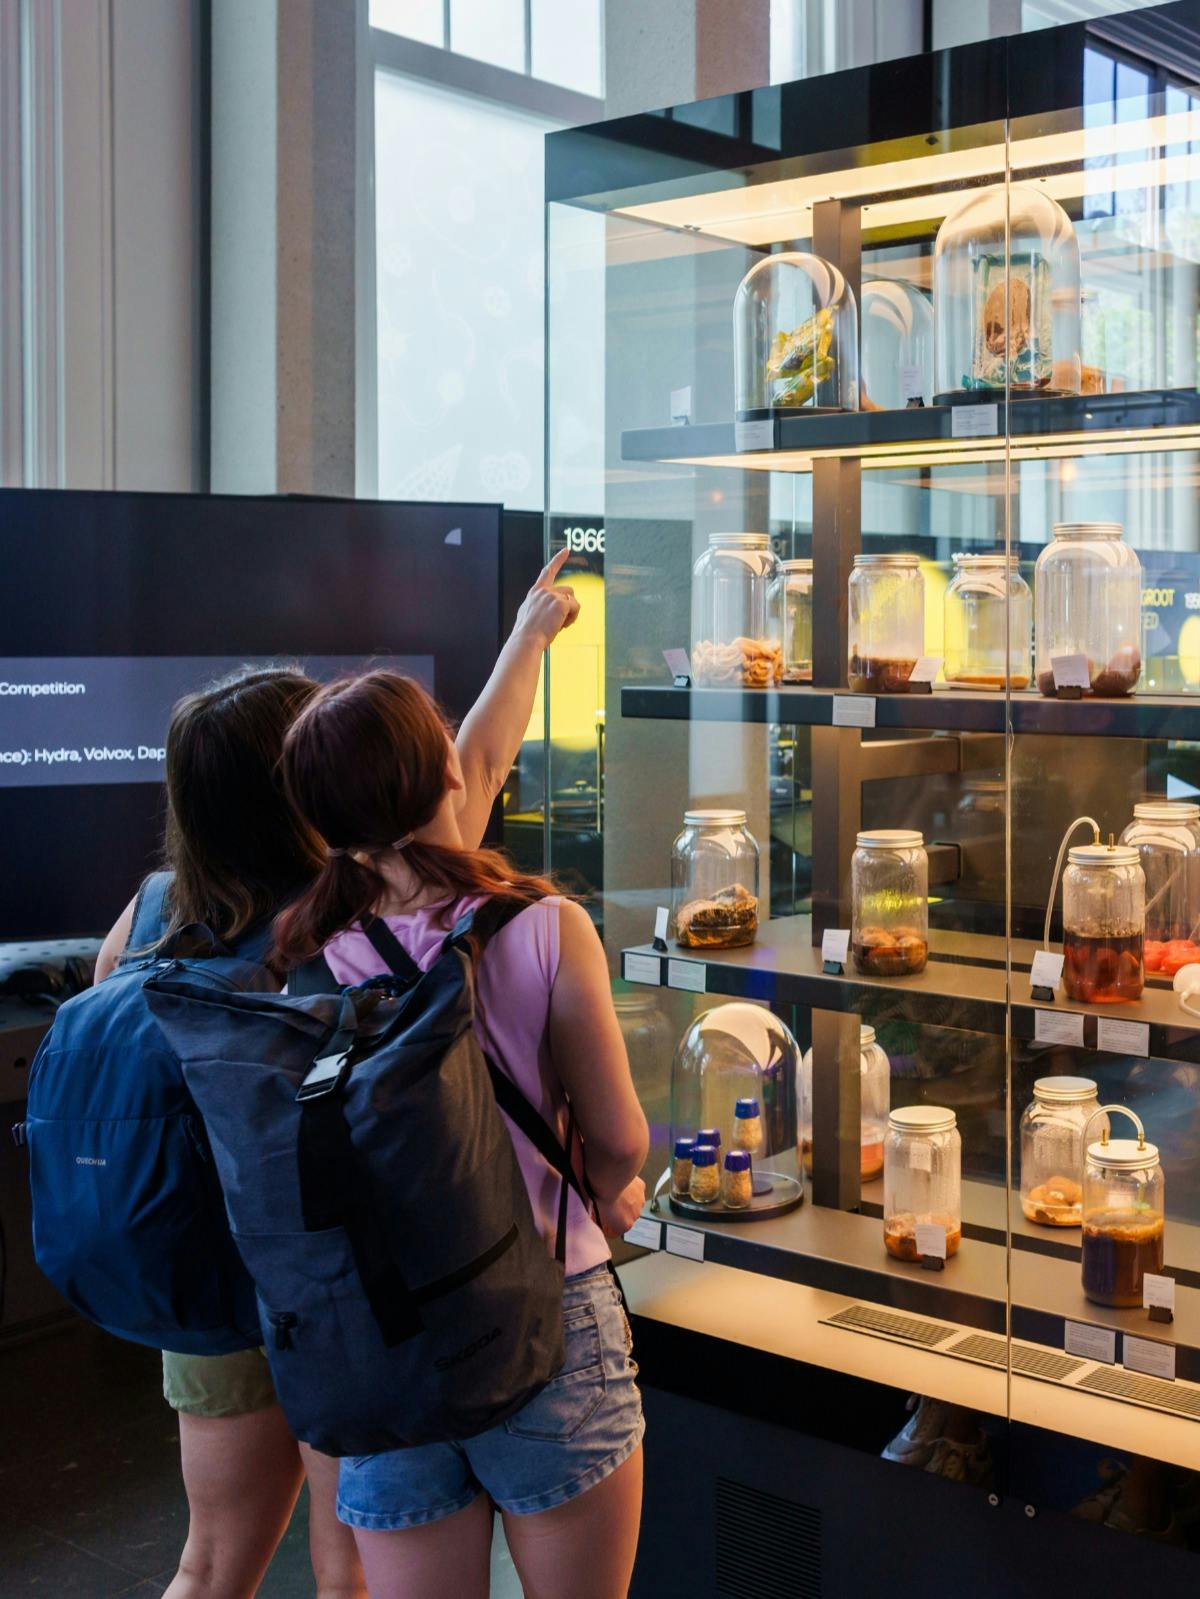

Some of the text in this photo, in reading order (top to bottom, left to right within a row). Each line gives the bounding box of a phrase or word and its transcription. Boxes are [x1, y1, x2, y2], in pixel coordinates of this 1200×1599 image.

[0, 682, 86, 697] Competition
[34, 748, 82, 764] Hydra,
[84, 746, 135, 761] Volvox,
